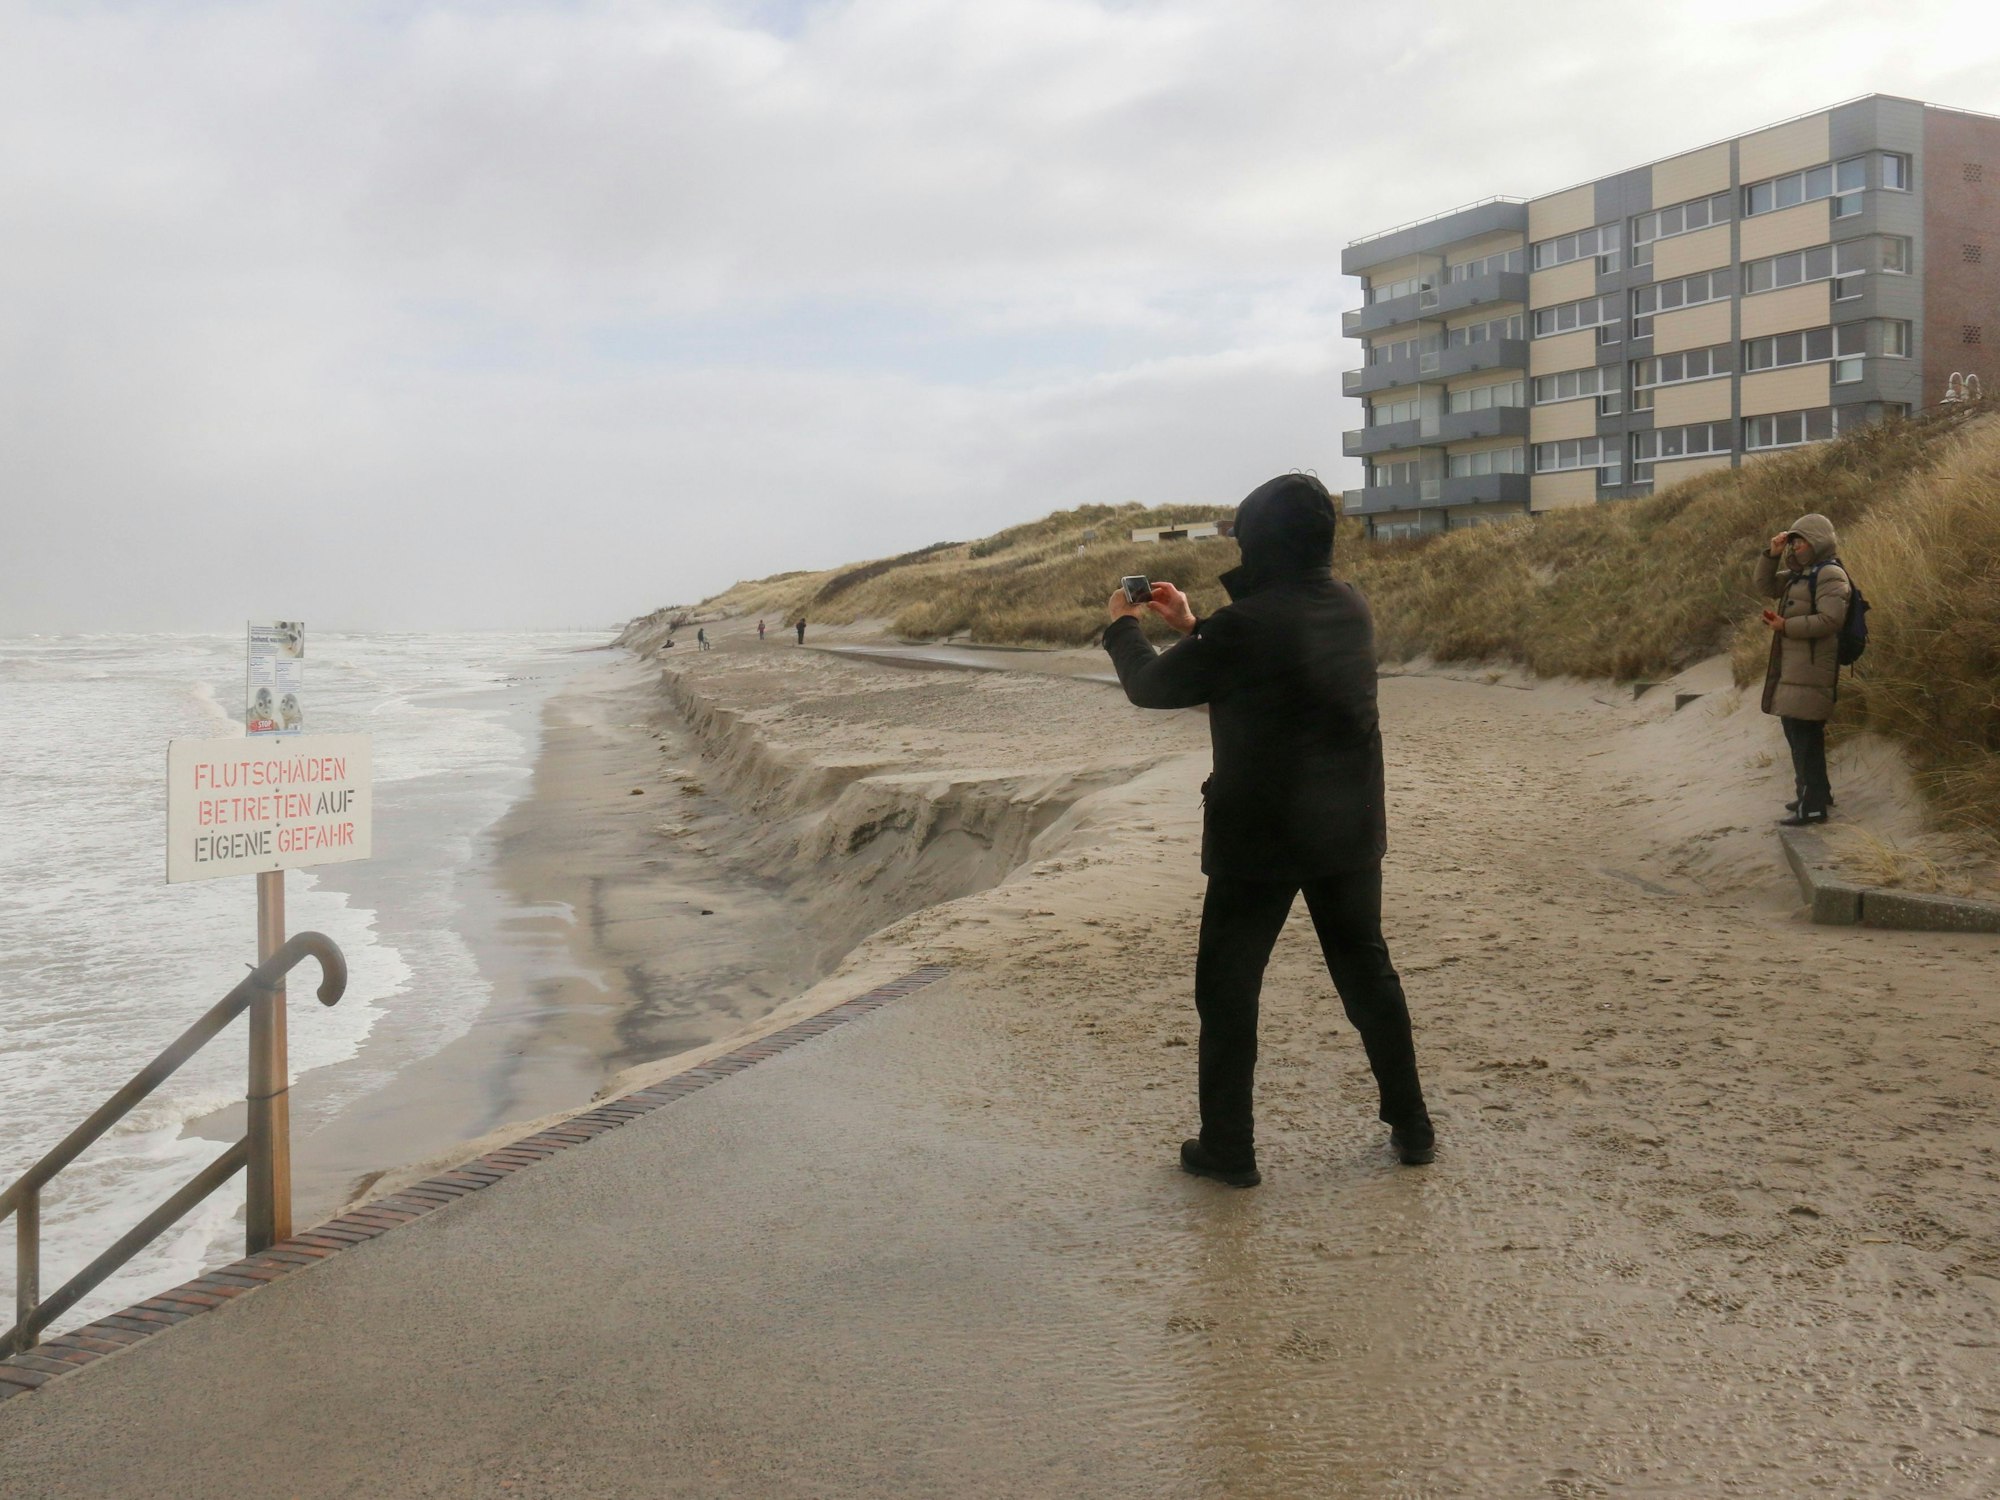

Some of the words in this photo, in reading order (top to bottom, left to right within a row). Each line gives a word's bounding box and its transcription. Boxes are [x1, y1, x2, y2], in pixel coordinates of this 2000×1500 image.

[257, 720, 272, 728] STOP
[194, 754, 346, 790] FLUTSCHÄDEN
[198, 792, 312, 826] BETRETEN
[316, 789, 355, 815] AUF
[277, 822, 354, 853] GEFAHR
